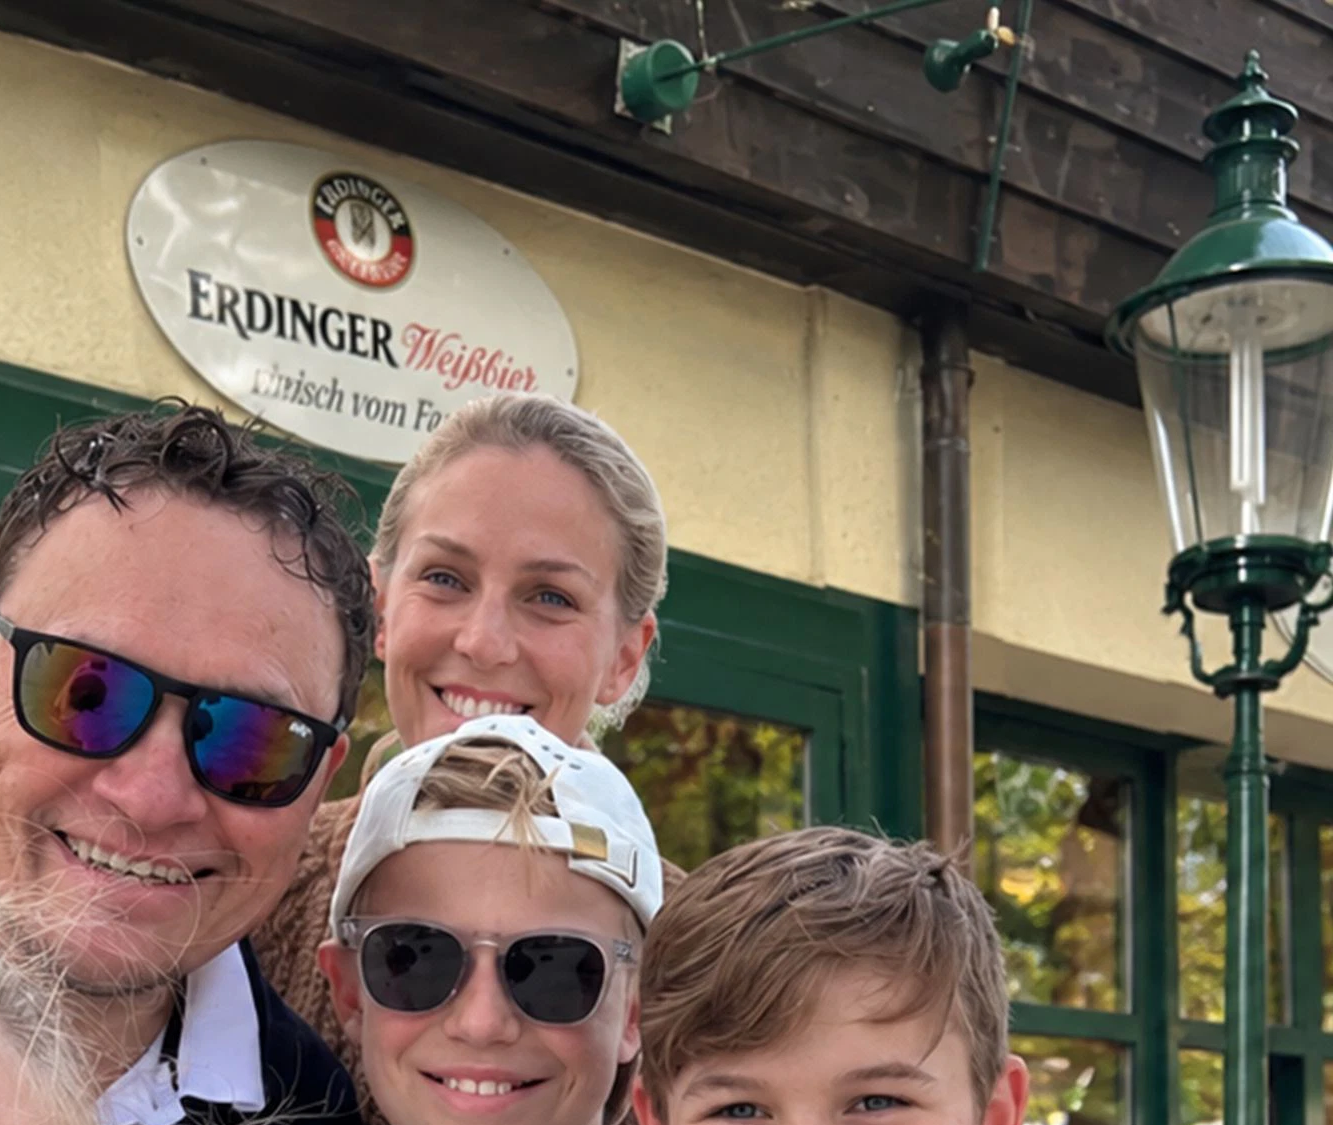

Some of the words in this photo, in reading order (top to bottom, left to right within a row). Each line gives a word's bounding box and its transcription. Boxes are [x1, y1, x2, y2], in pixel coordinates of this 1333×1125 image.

[186, 268, 399, 369] ERDINGER
[400, 321, 539, 392] Weißbier
[352, 390, 408, 429] vom
